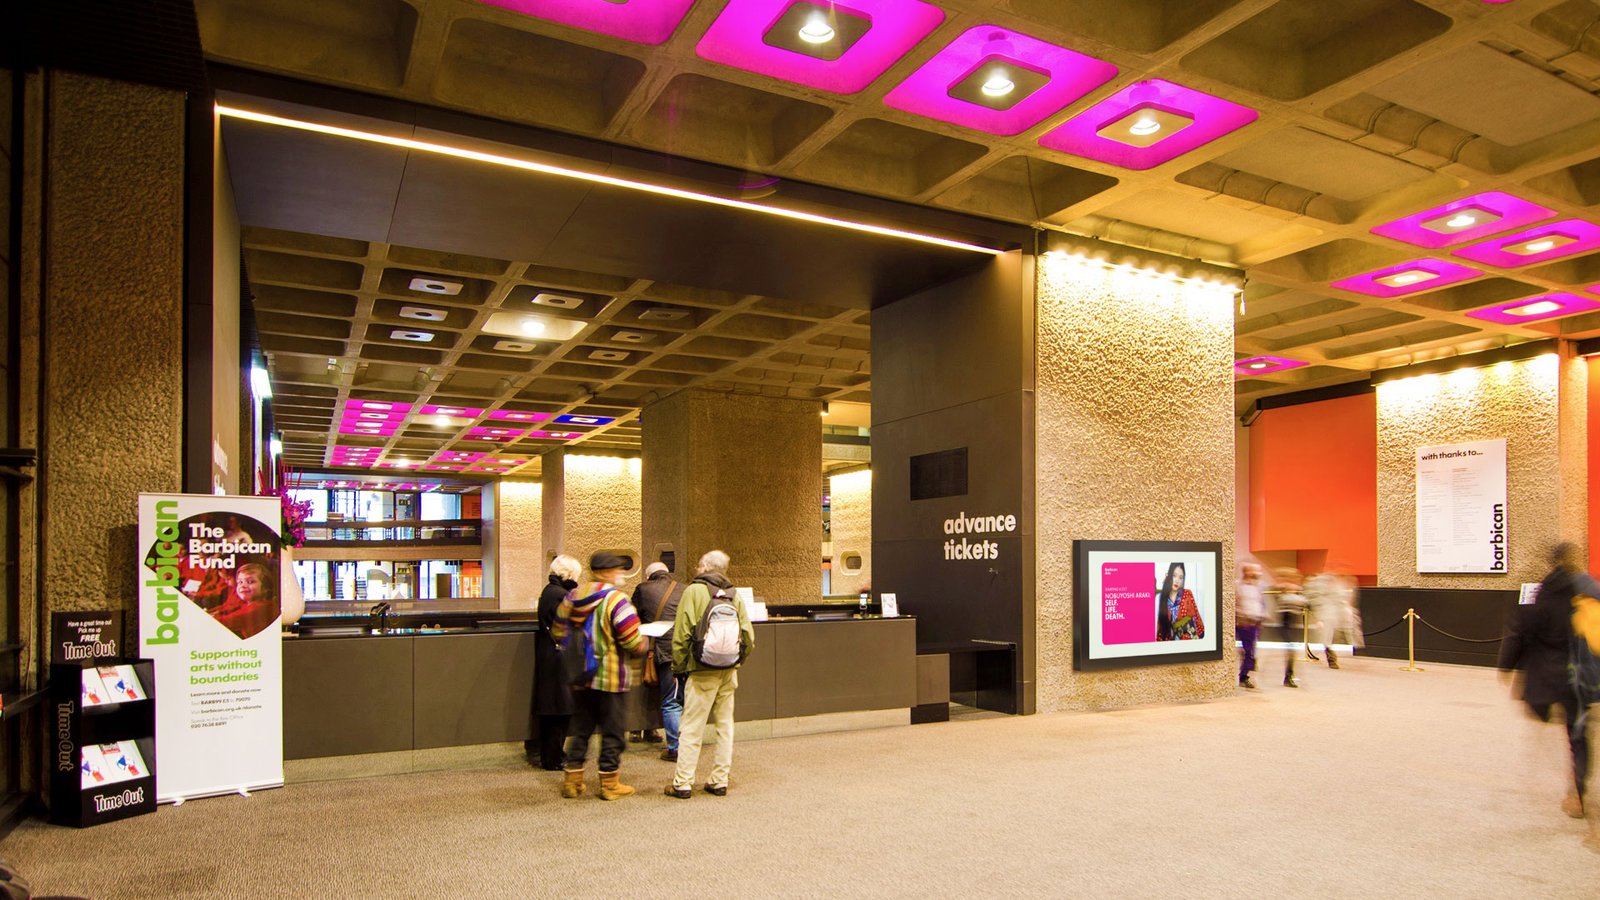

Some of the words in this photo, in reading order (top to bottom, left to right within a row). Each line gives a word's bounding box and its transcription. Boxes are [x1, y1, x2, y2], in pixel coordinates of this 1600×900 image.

[1421, 453, 1438, 461] with
[1439, 450, 1466, 459] thanks
[189, 522, 225, 538] The
[943, 511, 1016, 534] advance
[1490, 503, 1503, 570] barbican
[189, 539, 272, 554] Barbican
[943, 538, 999, 560] tickets
[189, 554, 236, 569] Fund
[146, 500, 180, 645] barbican
[80, 634, 100, 642] FREE
[63, 641, 93, 660] Time
[93, 640, 116, 657] Out
[190, 648, 258, 661] Supporting
[190, 664, 215, 672] arts
[217, 660, 262, 671] without
[190, 672, 259, 685] boundaries
[58, 701, 74, 740] Time
[59, 741, 74, 771] Out
[94, 794, 122, 812] Time
[122, 787, 144, 806] Out
